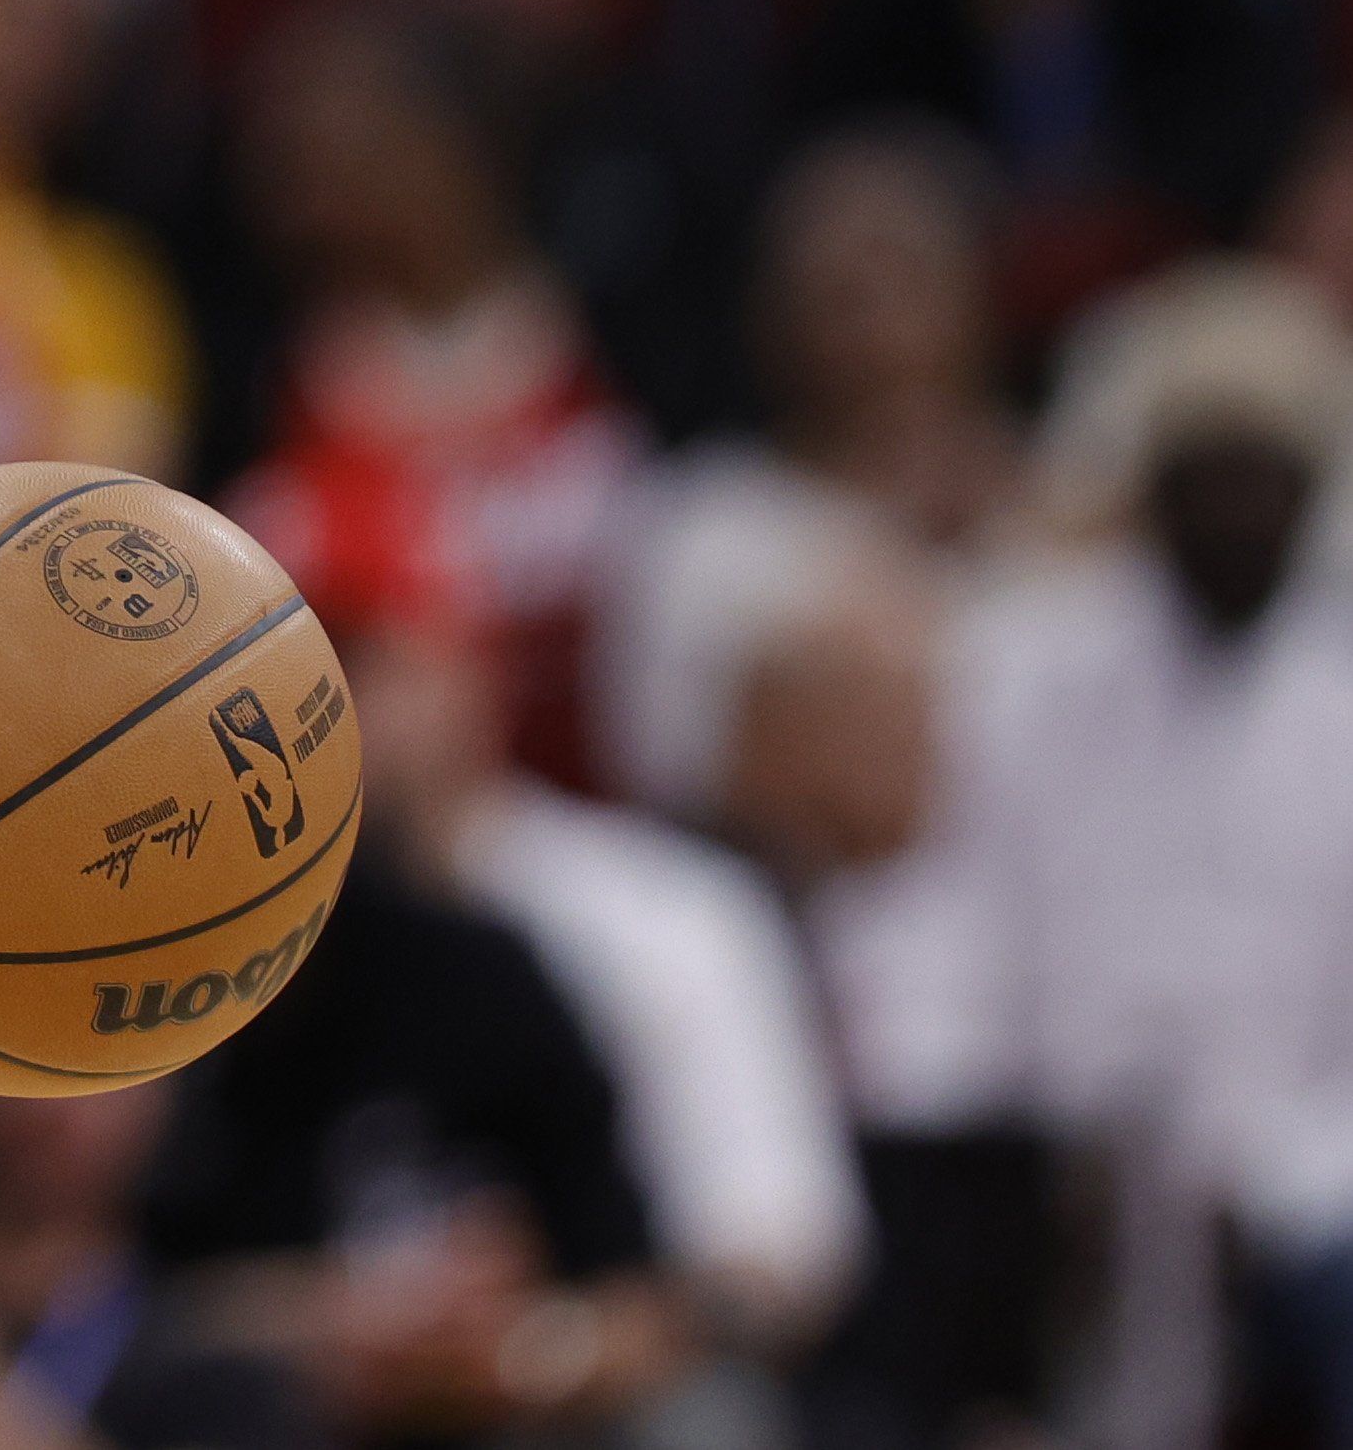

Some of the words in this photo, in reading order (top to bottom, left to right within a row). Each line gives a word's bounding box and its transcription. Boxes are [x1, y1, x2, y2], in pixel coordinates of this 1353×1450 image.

[85, 616, 104, 633] USA
[108, 626, 119, 637] IN
[122, 621, 169, 639] DESIGNED
[103, 796, 179, 845] COMMISSIONER
